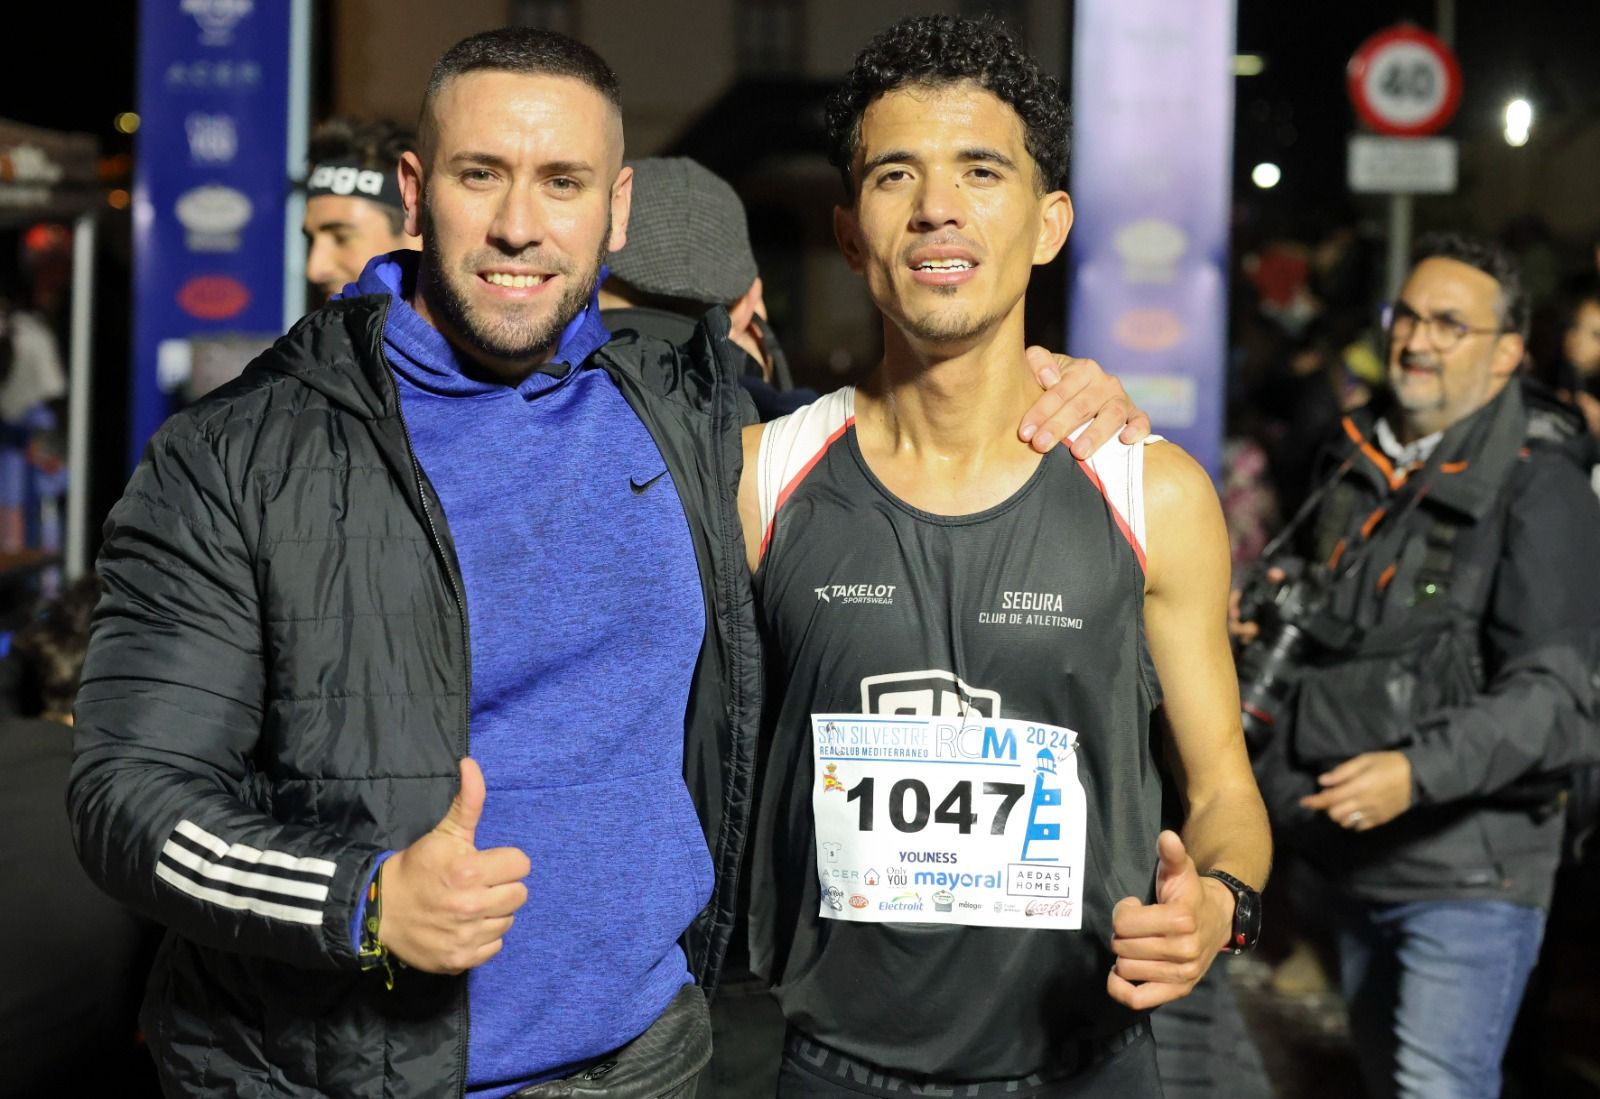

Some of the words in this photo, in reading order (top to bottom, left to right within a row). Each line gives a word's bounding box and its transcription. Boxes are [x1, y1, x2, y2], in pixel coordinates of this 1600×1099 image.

[1379, 61, 1436, 101] 40
[831, 584, 897, 598] TAKELOT
[841, 597, 893, 605] SPORTSWEAR
[1002, 591, 1063, 612] SEGURA
[978, 612, 1007, 624] CLUB
[1009, 613, 1023, 625] DE
[1025, 614, 1083, 630] ATLETISMO
[850, 726, 929, 746] SILVESTRE
[935, 724, 1017, 761] RCM
[1026, 726, 1068, 751] 2024
[847, 777, 1026, 836] 1047
[899, 851, 958, 864] YOUNESS
[822, 869, 860, 880] ACER
[886, 866, 908, 878] Only
[1016, 871, 1061, 881] AEDAS
[887, 875, 908, 886] YOU
[914, 870, 1002, 891] mayoral
[1016, 882, 1060, 892] HOMES
[878, 901, 924, 912] Electrolit
